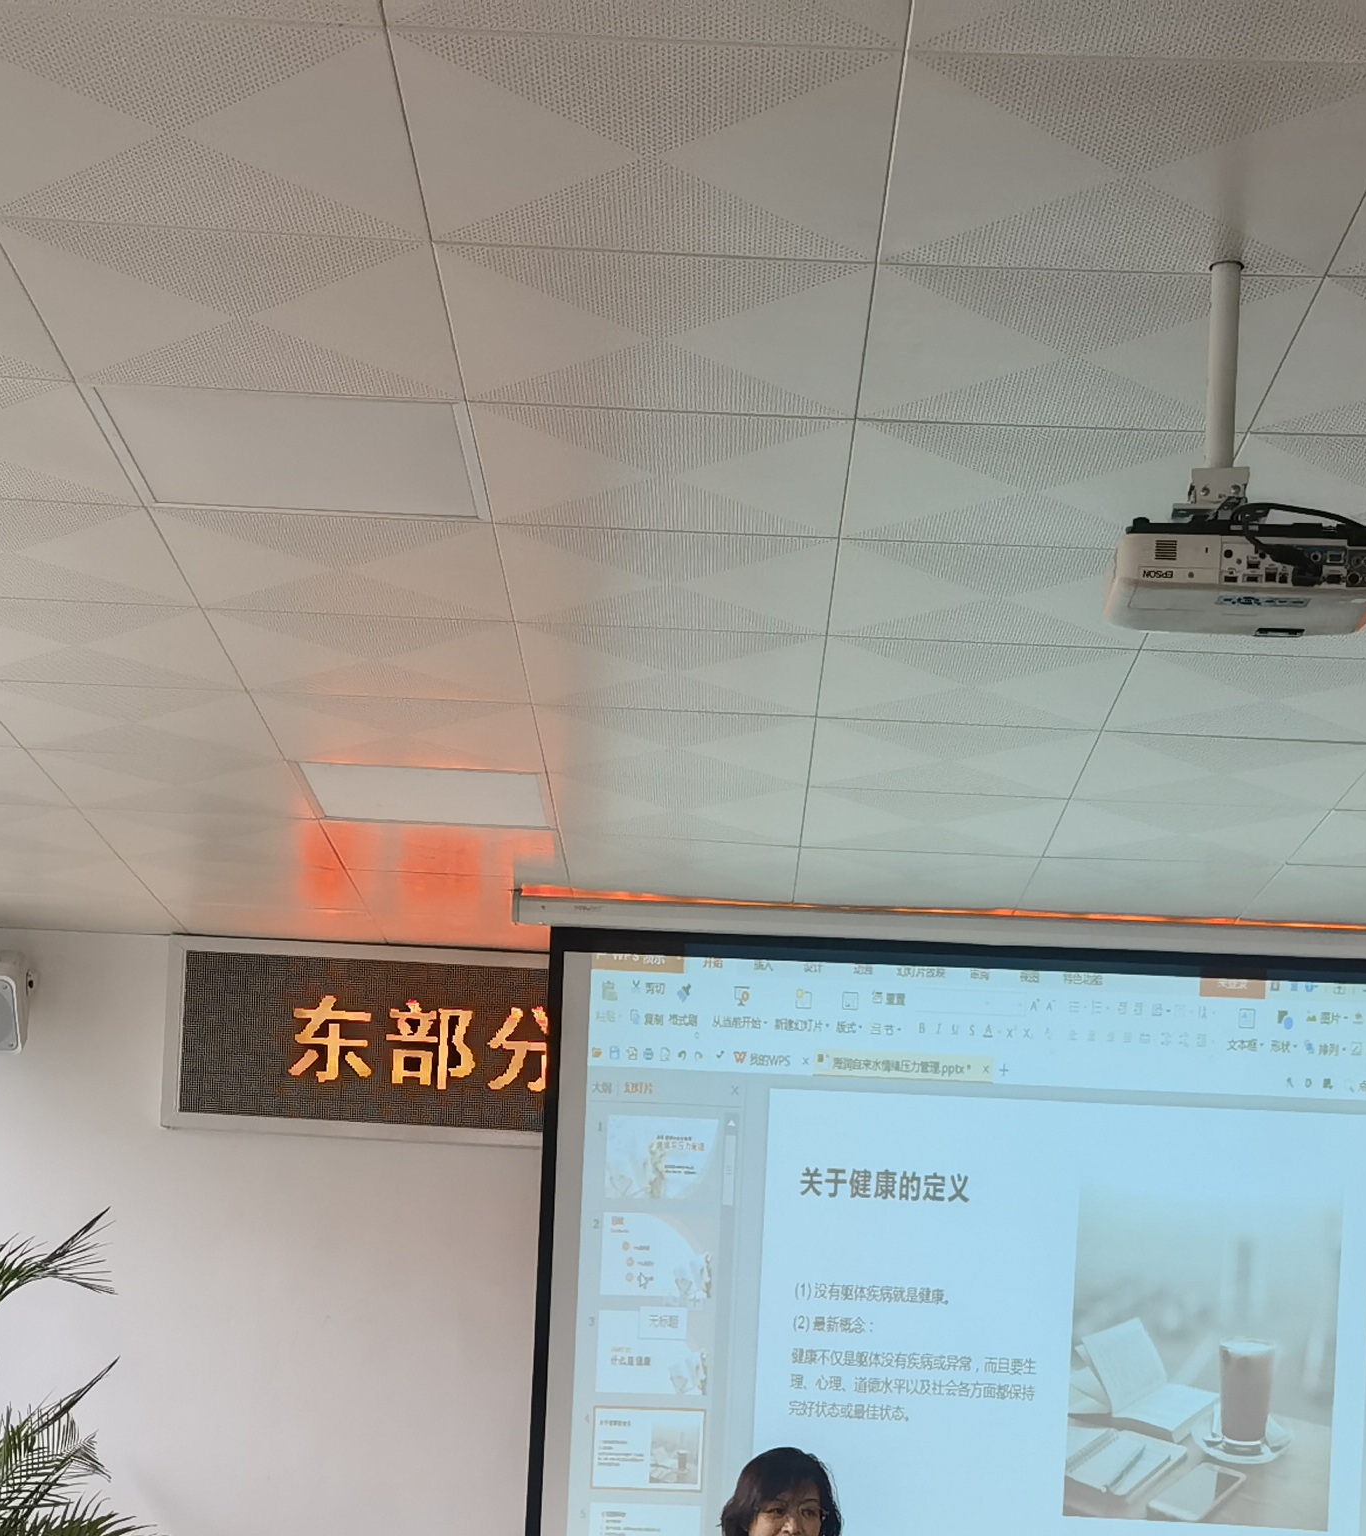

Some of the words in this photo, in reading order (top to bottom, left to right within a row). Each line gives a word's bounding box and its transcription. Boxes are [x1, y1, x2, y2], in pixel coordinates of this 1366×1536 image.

[1142, 570, 1174, 579] EPSON
[645, 982, 666, 995] 剪切
[712, 1015, 762, 1029] 从当前开始
[774, 1018, 823, 1032] 新建幻灯片
[1320, 1012, 1339, 1025] 图片
[836, 1020, 857, 1034] 版式
[288, 995, 548, 1092] 东部分
[1227, 1039, 1258, 1052] 文本框
[623, 1082, 653, 1094] 幻灯片
[799, 1166, 970, 1203] 关于健康的定义
[794, 1282, 812, 1300] (1)
[793, 1315, 810, 1332] (2)
